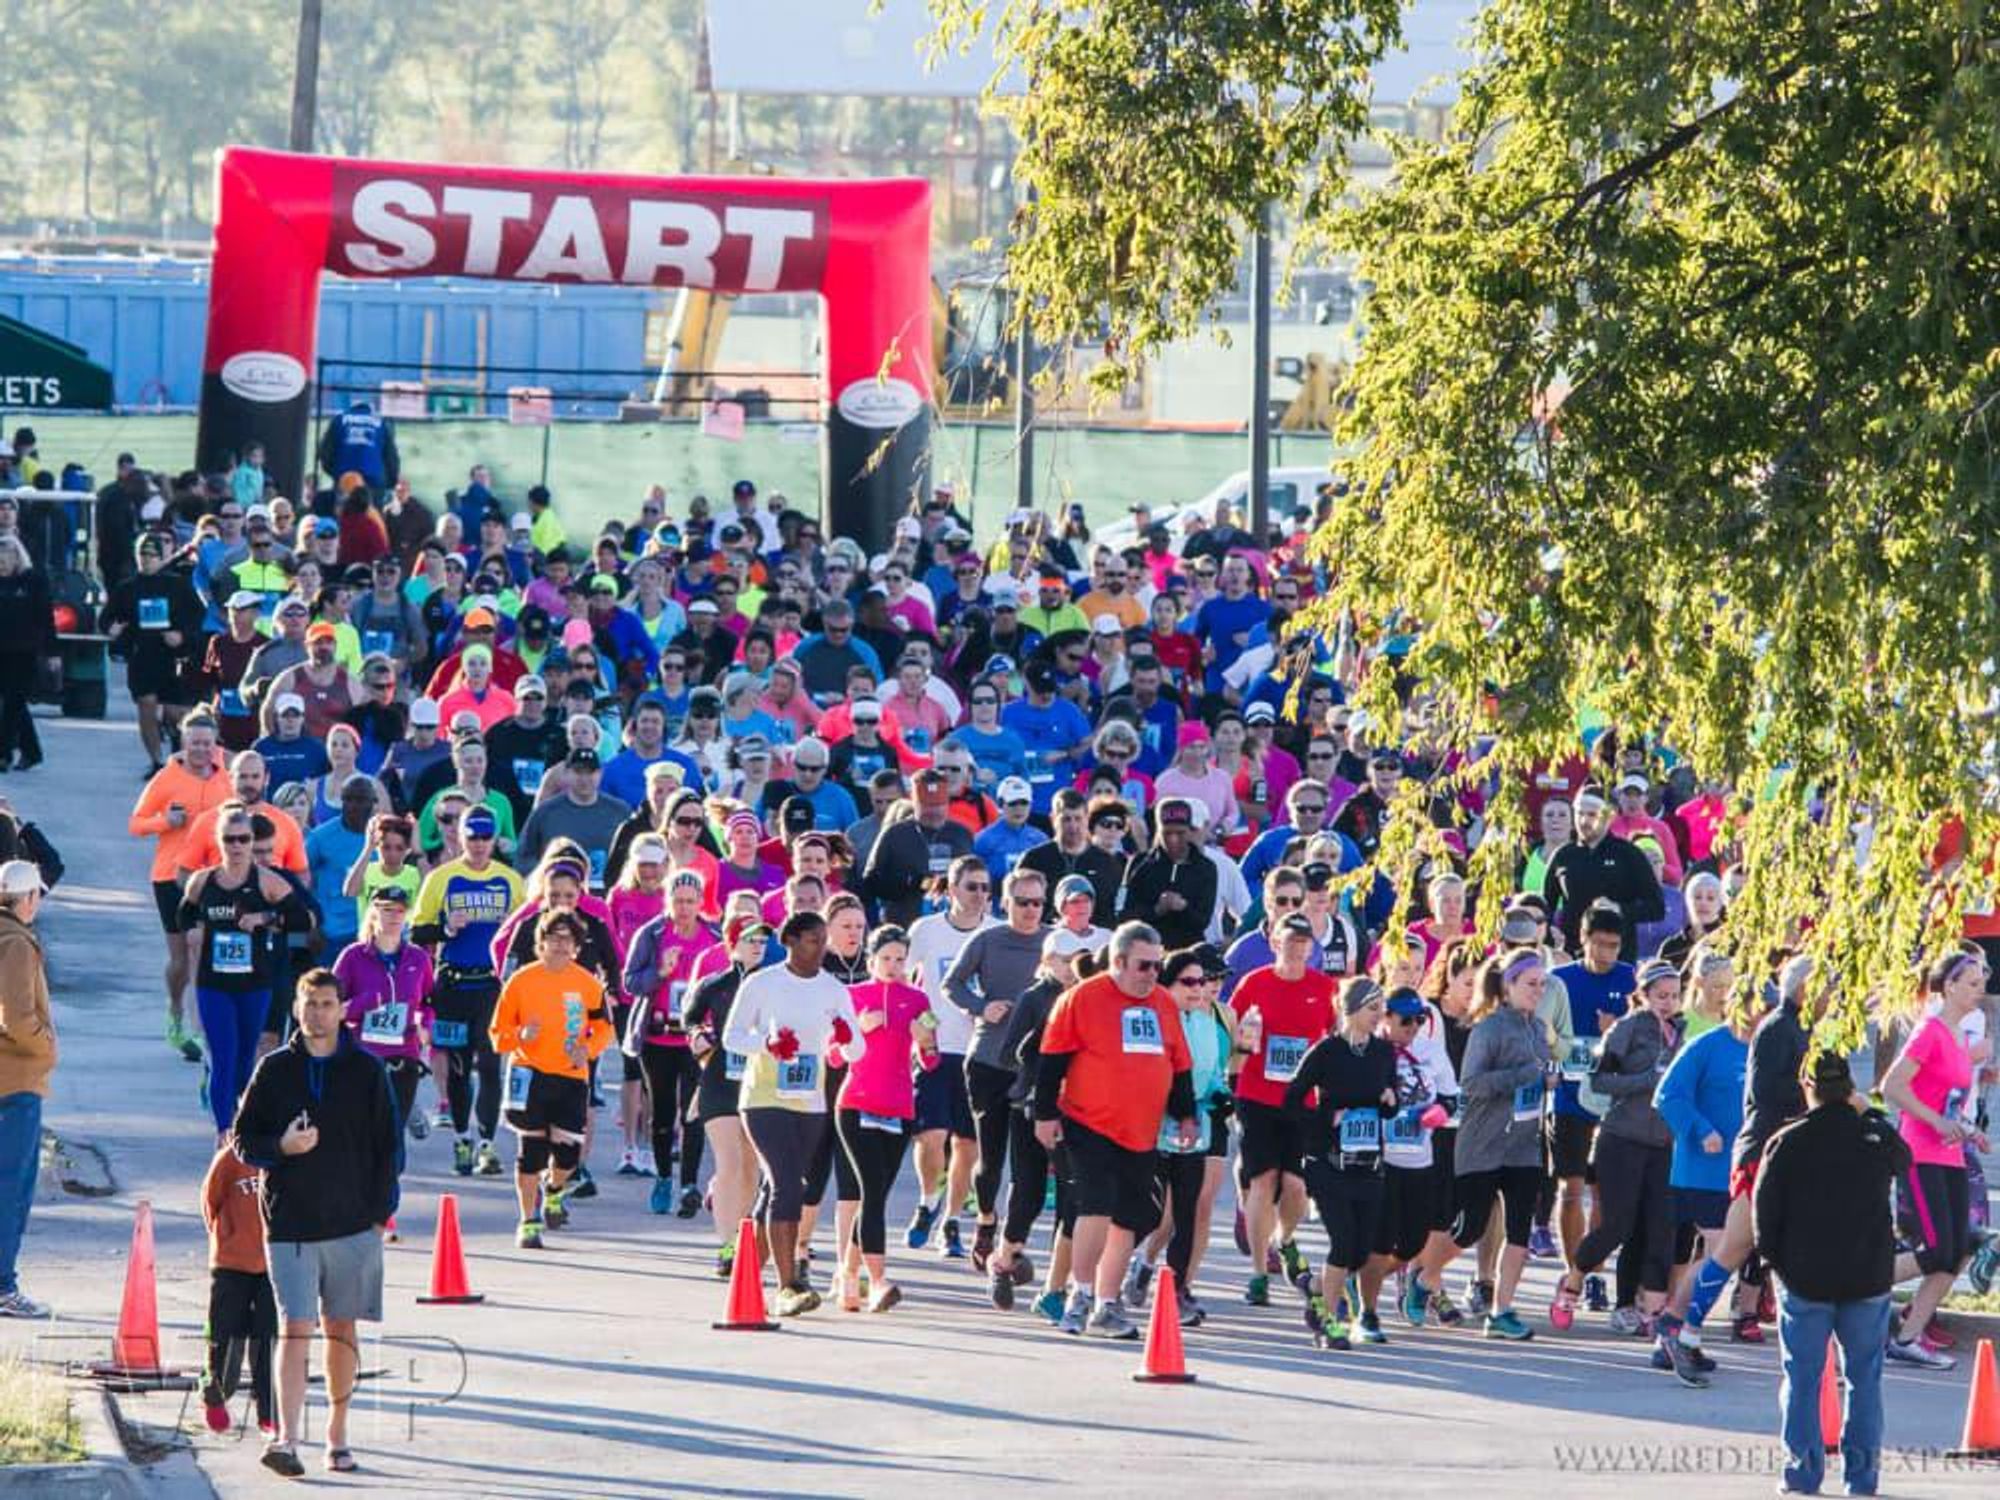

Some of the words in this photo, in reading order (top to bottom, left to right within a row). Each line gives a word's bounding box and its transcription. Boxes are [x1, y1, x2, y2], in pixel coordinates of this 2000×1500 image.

[344, 179, 815, 291] START
[0, 376, 61, 405] ETS
[1131, 1020, 1155, 1038] 615
